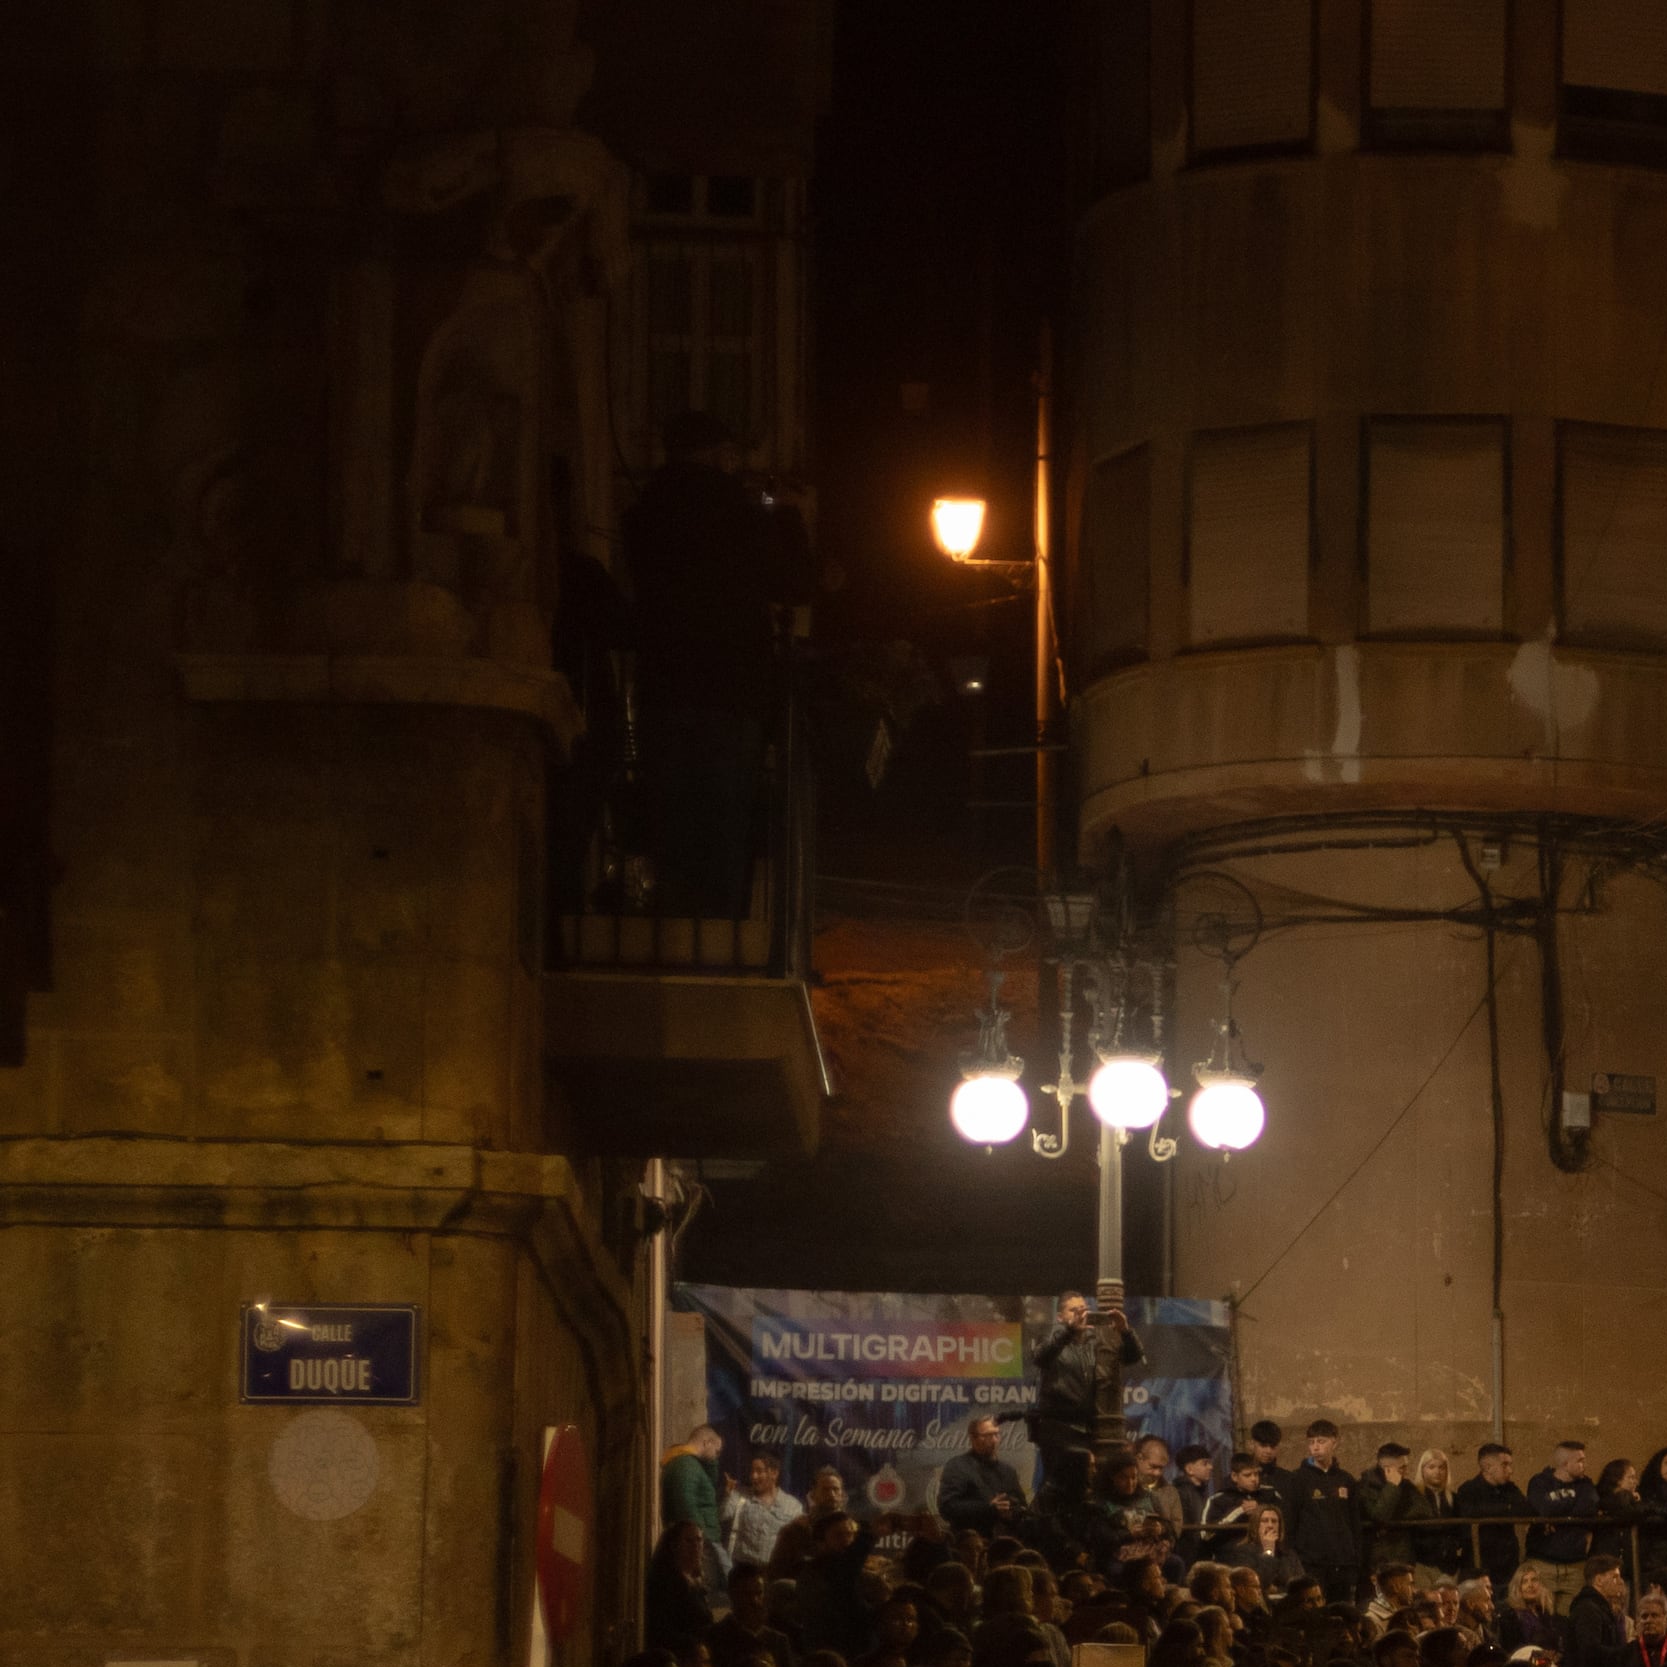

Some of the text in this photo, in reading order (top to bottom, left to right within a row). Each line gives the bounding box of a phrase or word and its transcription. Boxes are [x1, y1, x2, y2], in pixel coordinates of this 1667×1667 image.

[311, 1323, 353, 1342] CALLE
[761, 1331, 1014, 1364] MULTIGRAPHIC
[290, 1358, 371, 1394] DUQUE
[750, 1377, 875, 1401] IMPRESIÓN
[880, 1383, 970, 1403] DIGITAL
[749, 1422, 788, 1445] con
[793, 1413, 820, 1446] la
[823, 1415, 916, 1449] Semana
